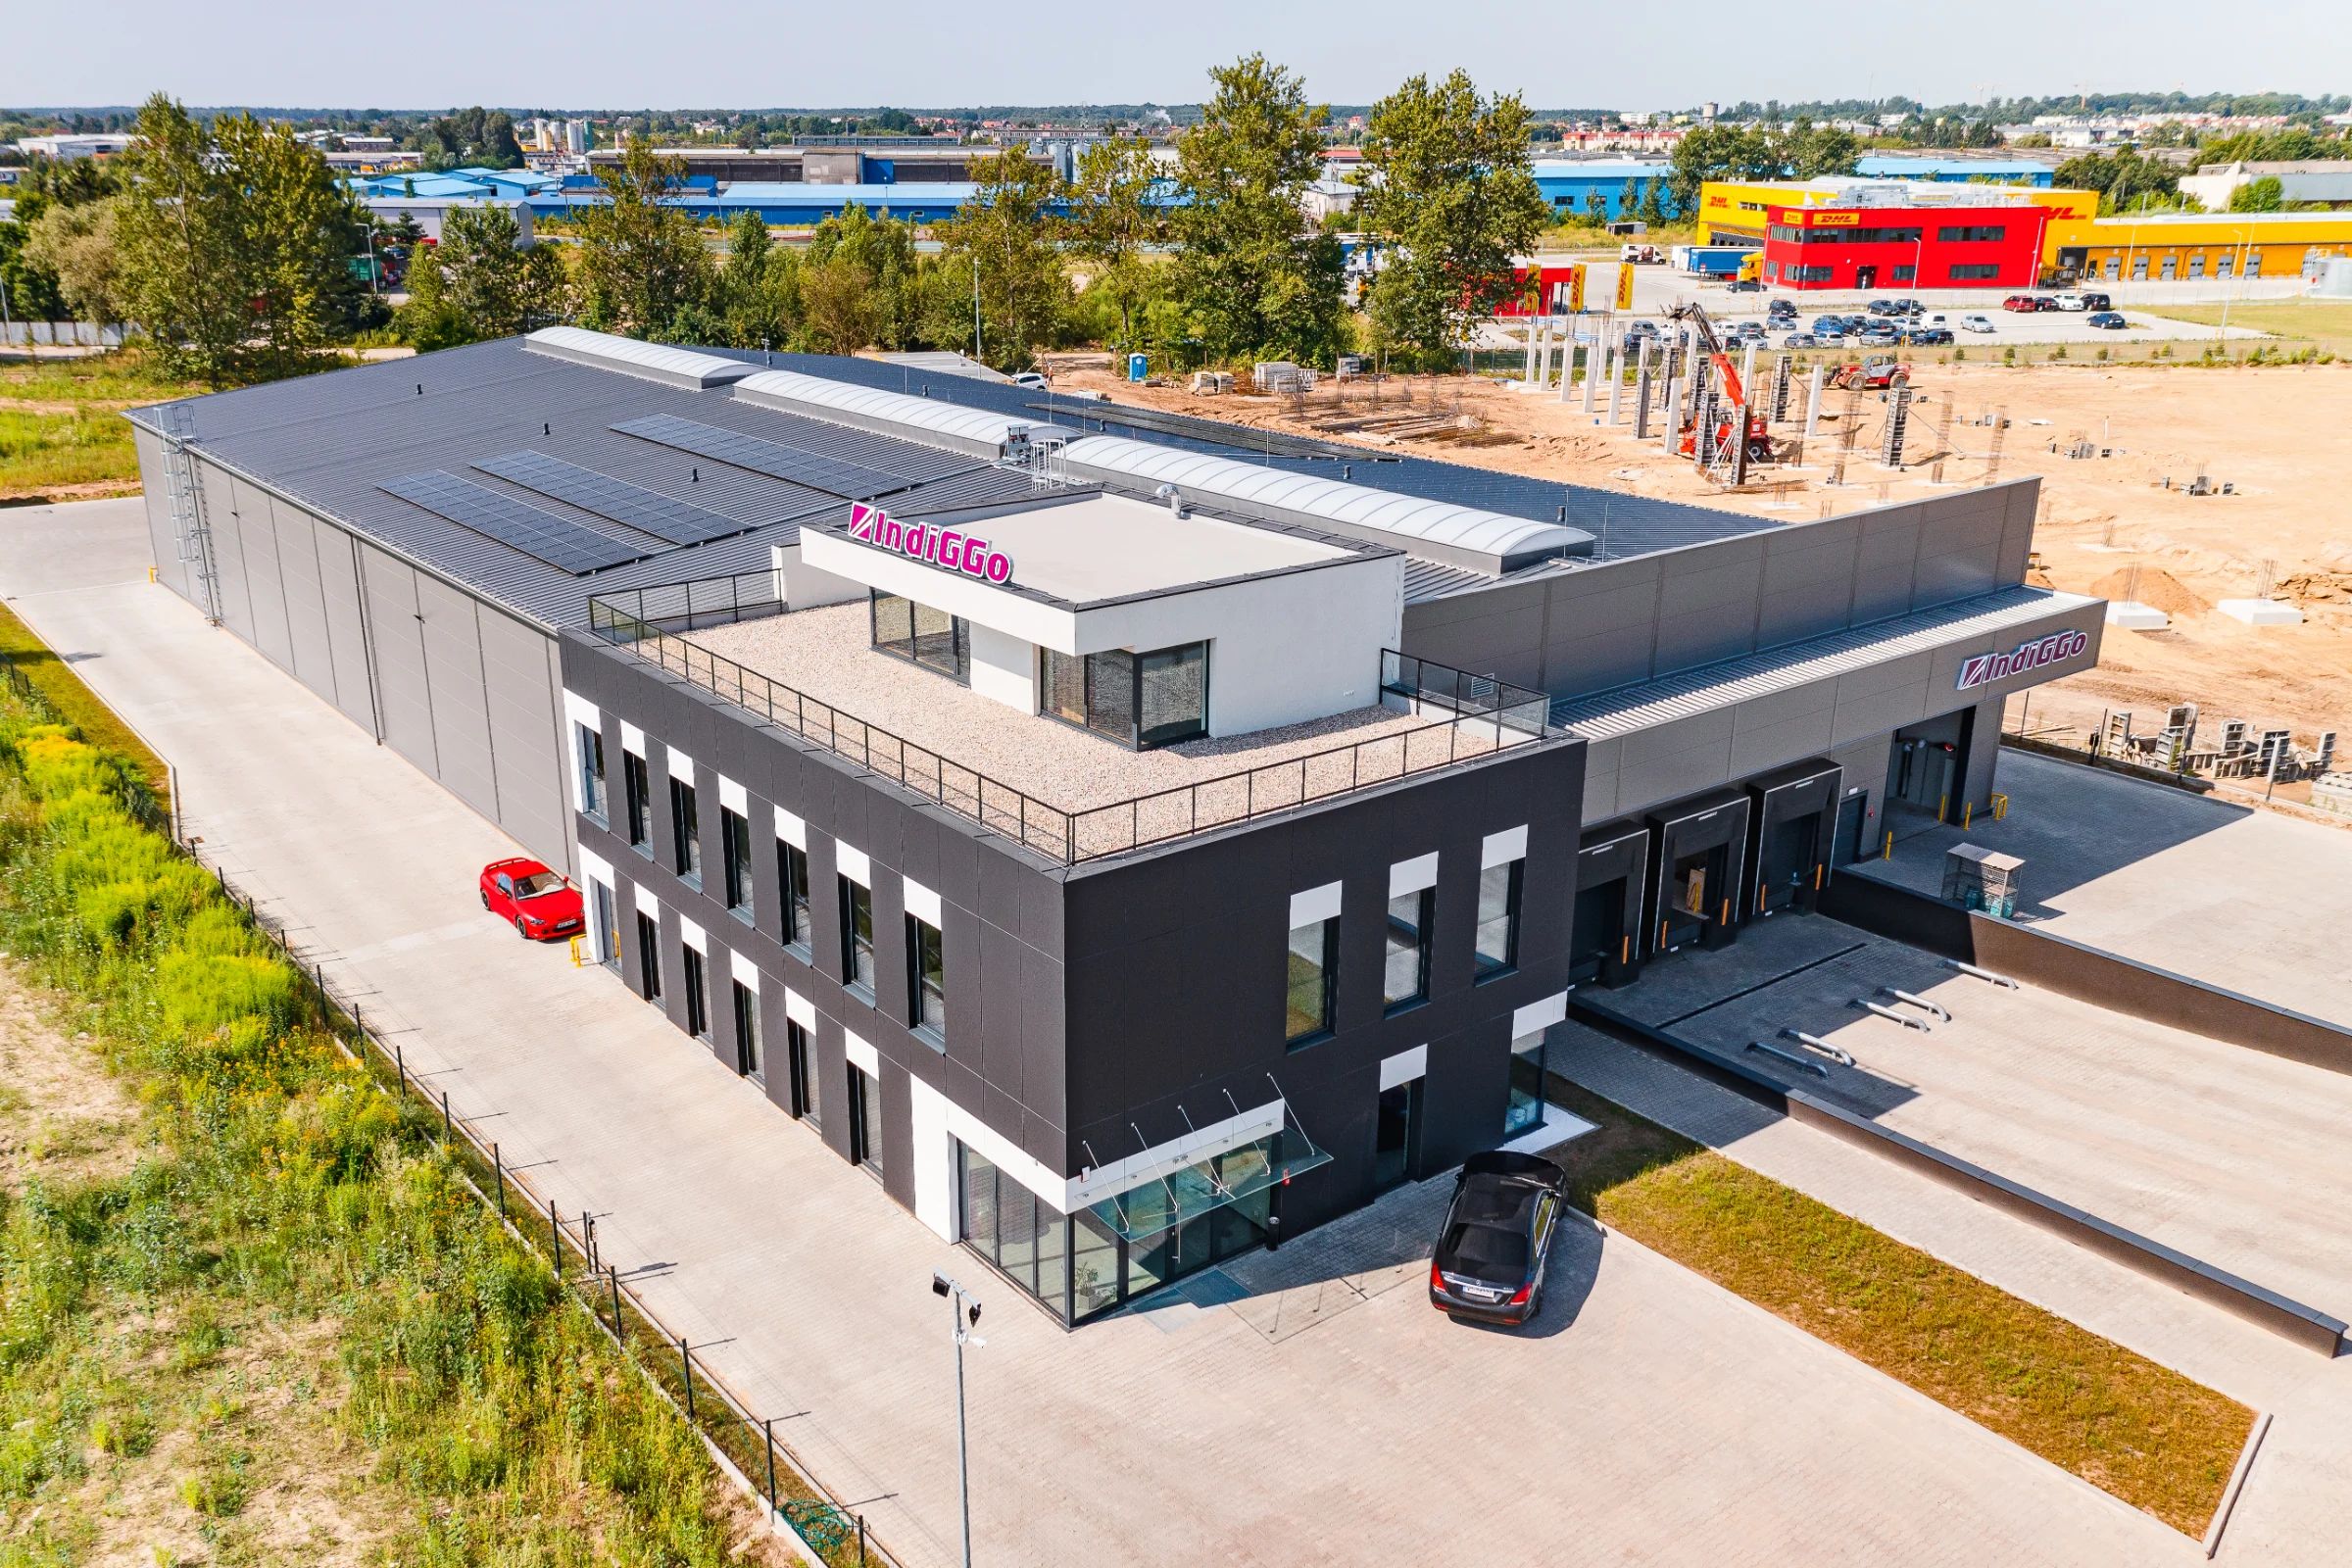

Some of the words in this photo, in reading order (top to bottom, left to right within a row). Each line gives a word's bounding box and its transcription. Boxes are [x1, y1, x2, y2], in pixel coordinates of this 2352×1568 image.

[1820, 215, 1854, 223] DHL
[1572, 270, 1581, 304] DHL
[1618, 270, 1628, 303] DHL
[872, 509, 1011, 585] IndiGGo
[1982, 631, 2087, 684] IndiGGo
